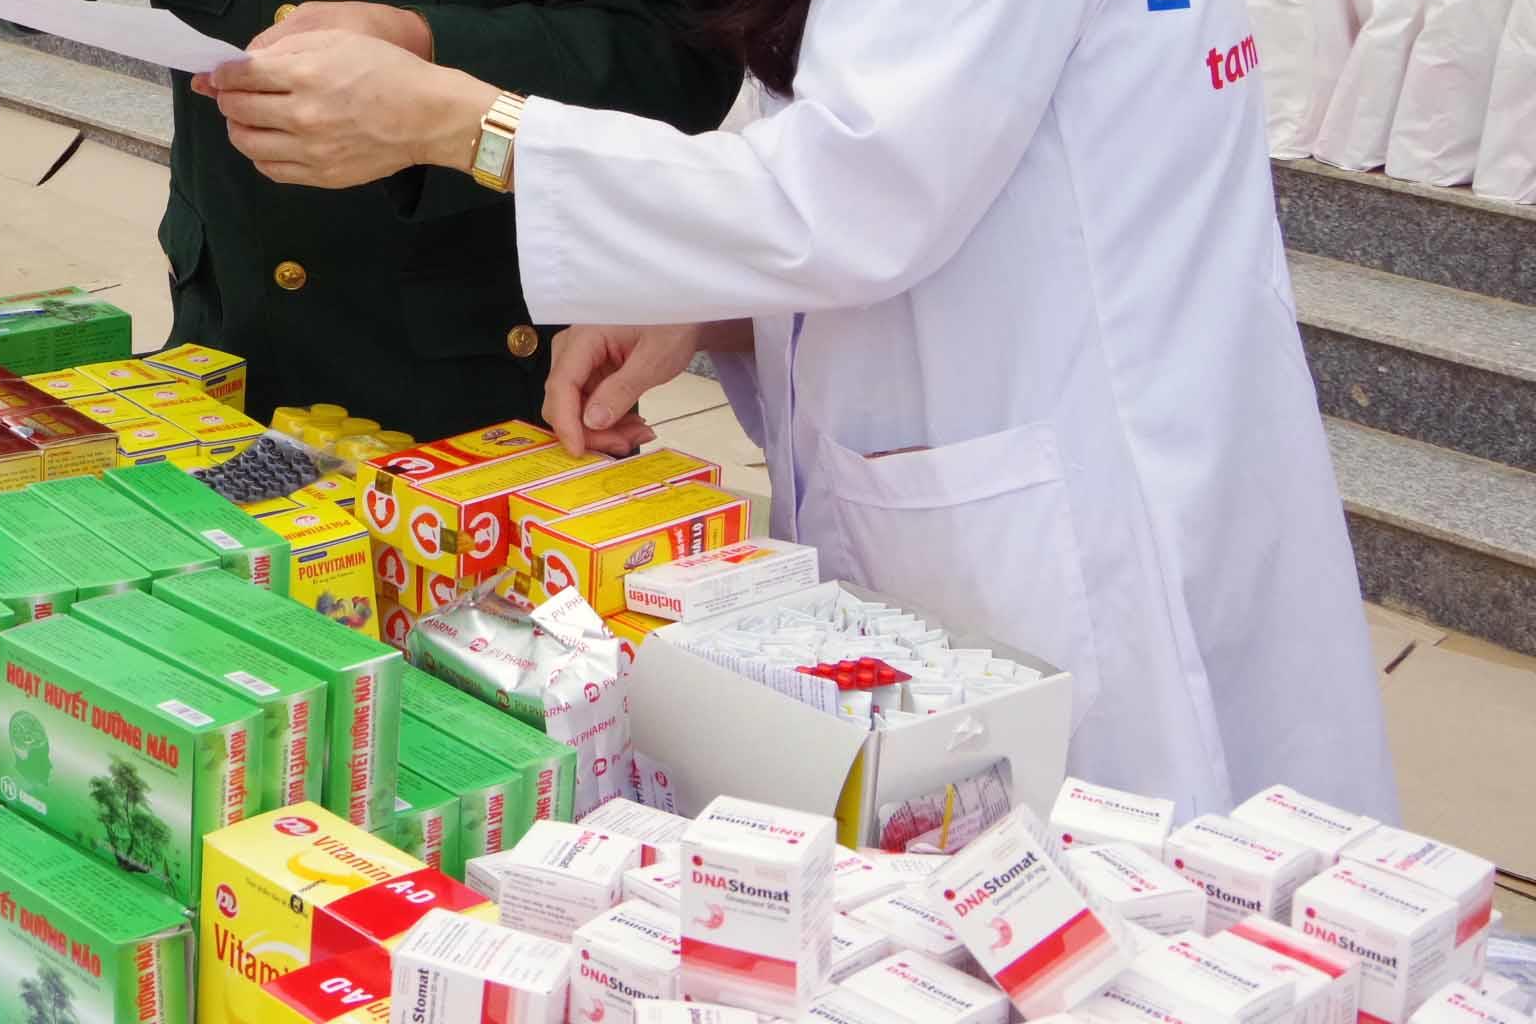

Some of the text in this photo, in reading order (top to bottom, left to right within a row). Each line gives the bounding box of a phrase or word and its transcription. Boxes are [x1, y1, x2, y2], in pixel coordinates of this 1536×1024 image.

[298, 551, 367, 581] POLYVITAMIN
[629, 588, 683, 613] Diclofen
[352, 674, 371, 702] NÃO
[6, 661, 179, 768] HOẠT HUYẾT DƯỠNG NÃO
[351, 704, 370, 750] DƯỠNG
[579, 716, 617, 742] PHARMA
[226, 730, 247, 765] HOẠT
[347, 753, 368, 793] HUYẾT
[312, 835, 393, 881] Vitamin
[692, 869, 791, 903] DNAStomat
[953, 849, 1040, 918] DNAStomat
[20, 907, 67, 956] DƯỠNG
[71, 940, 102, 977] NÃO
[1303, 920, 1398, 969] DNAStomat
[412, 967, 430, 1024] Stomat
